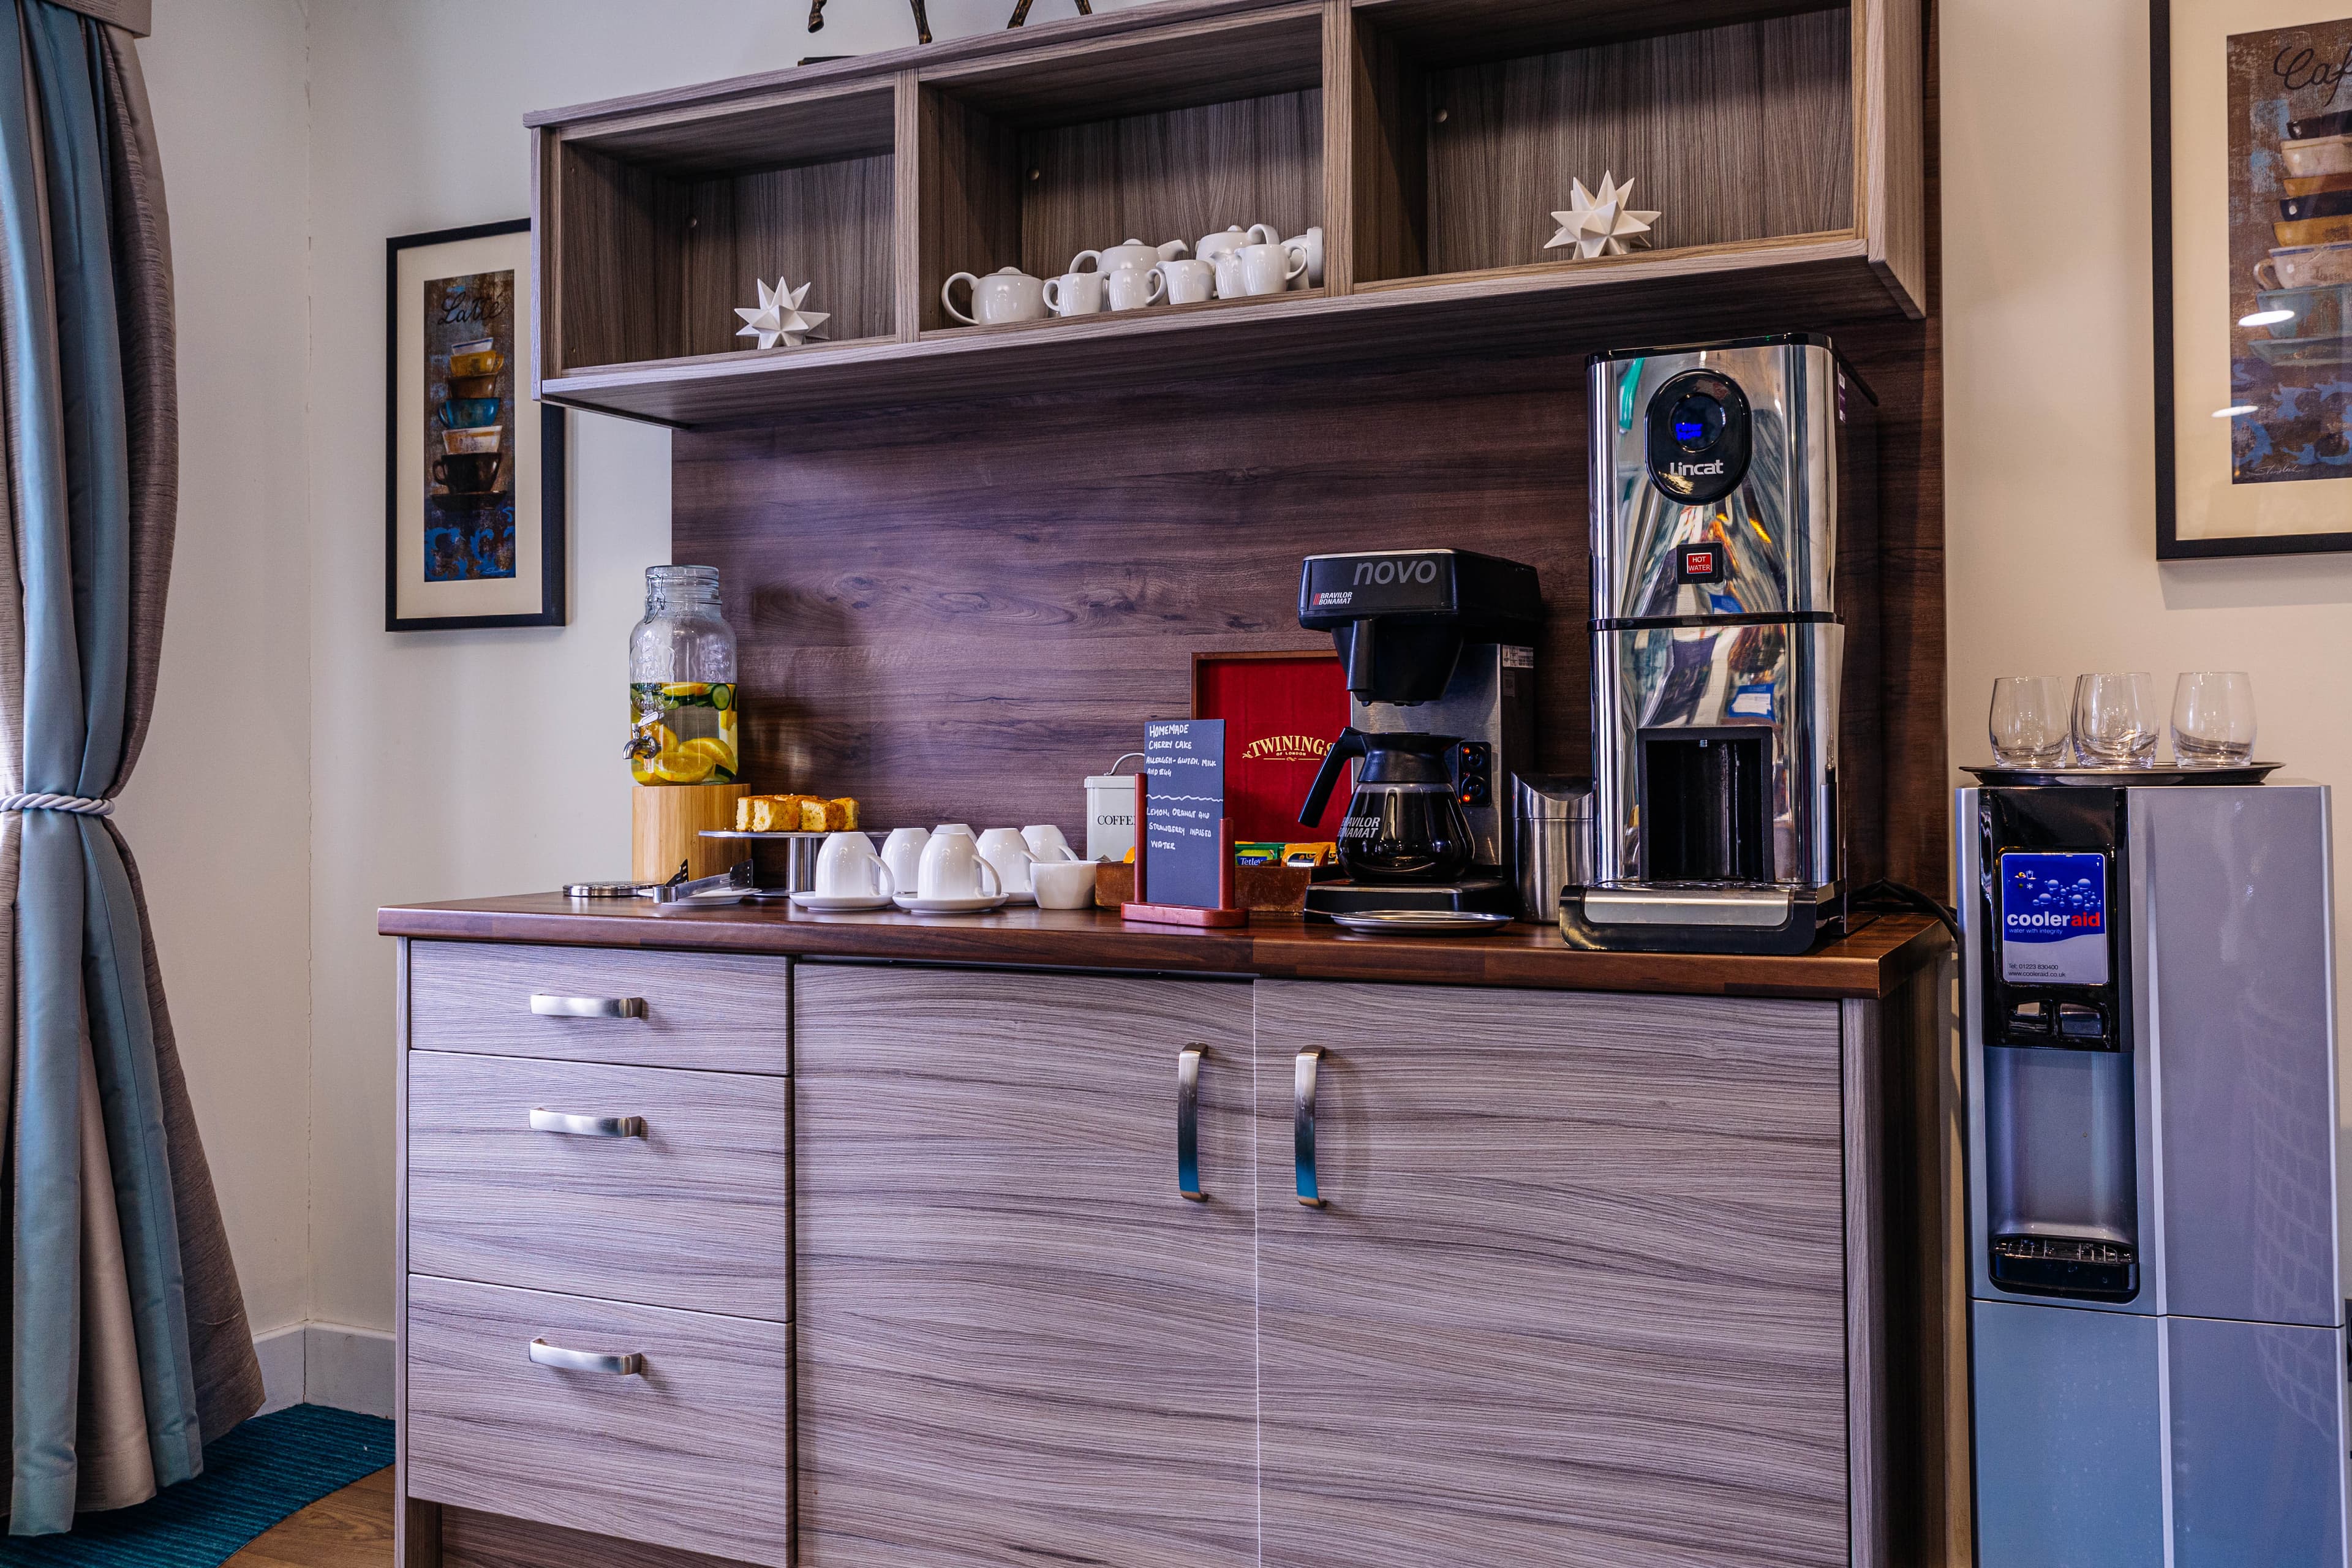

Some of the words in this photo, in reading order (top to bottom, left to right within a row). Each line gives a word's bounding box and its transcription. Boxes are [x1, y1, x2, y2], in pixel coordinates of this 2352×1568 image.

[1353, 560, 1436, 586] novo
[1149, 724, 1189, 737] HOMEMADE
[1148, 741, 1172, 750] CHERRY
[1175, 741, 1192, 749] CAKE
[1159, 769, 1172, 777] EGG
[1172, 808, 1196, 818] ORANGE
[1097, 815, 1136, 826] COFFE
[1148, 822, 1185, 836] STRAWBERRY
[1151, 840, 1176, 850] WATER
[2007, 911, 2100, 926] cooleraid
